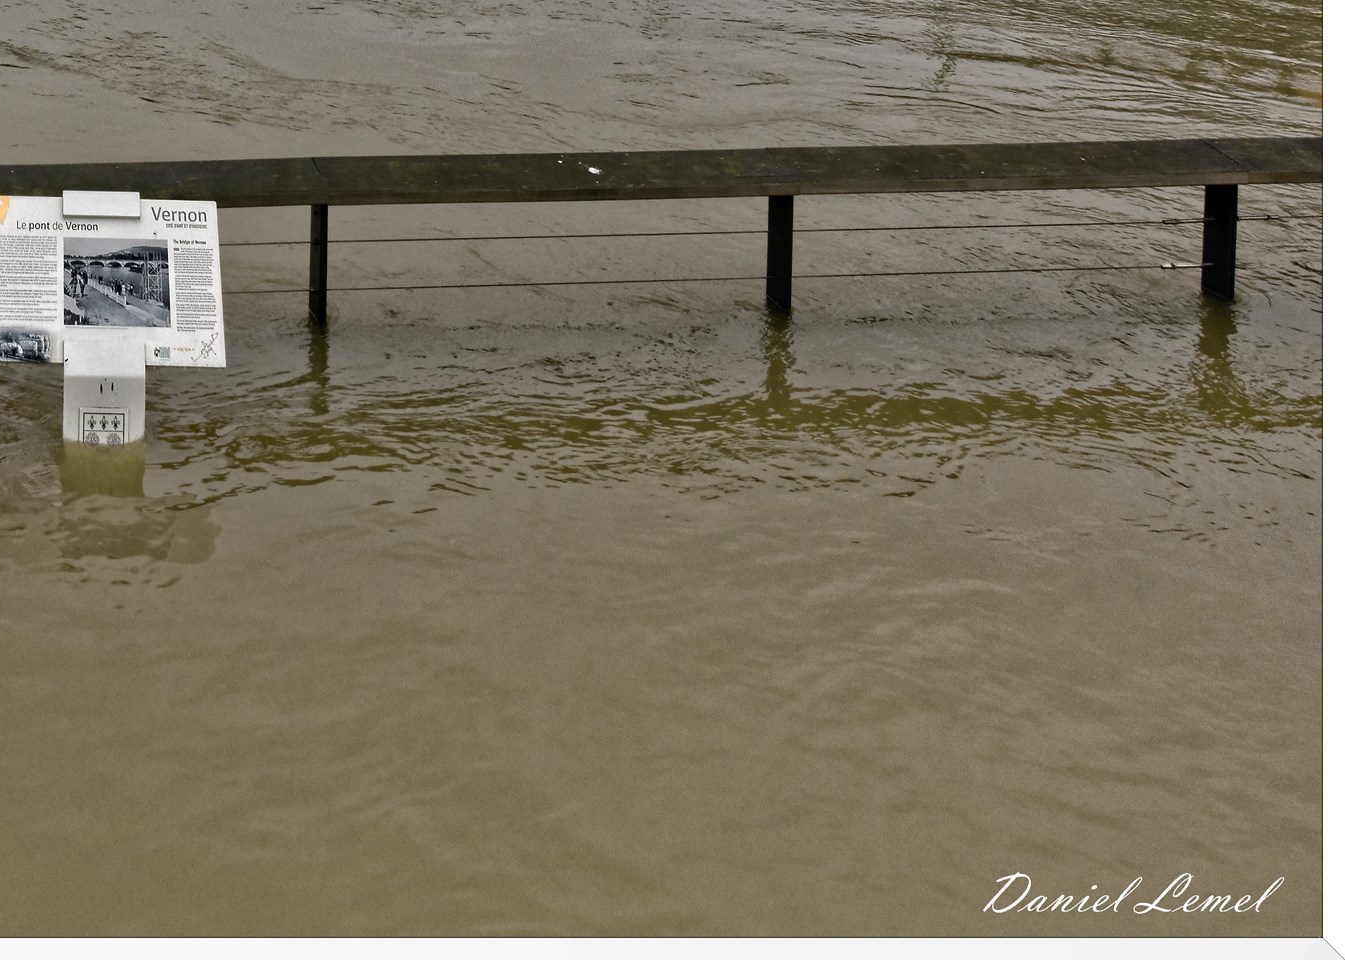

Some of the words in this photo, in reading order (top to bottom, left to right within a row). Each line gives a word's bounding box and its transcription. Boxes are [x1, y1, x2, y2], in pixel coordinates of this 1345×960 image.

[151, 206, 207, 222] Vernon
[16, 220, 26, 229] Le
[29, 222, 50, 231] pont
[52, 221, 63, 230] de
[65, 222, 98, 231] Vernon
